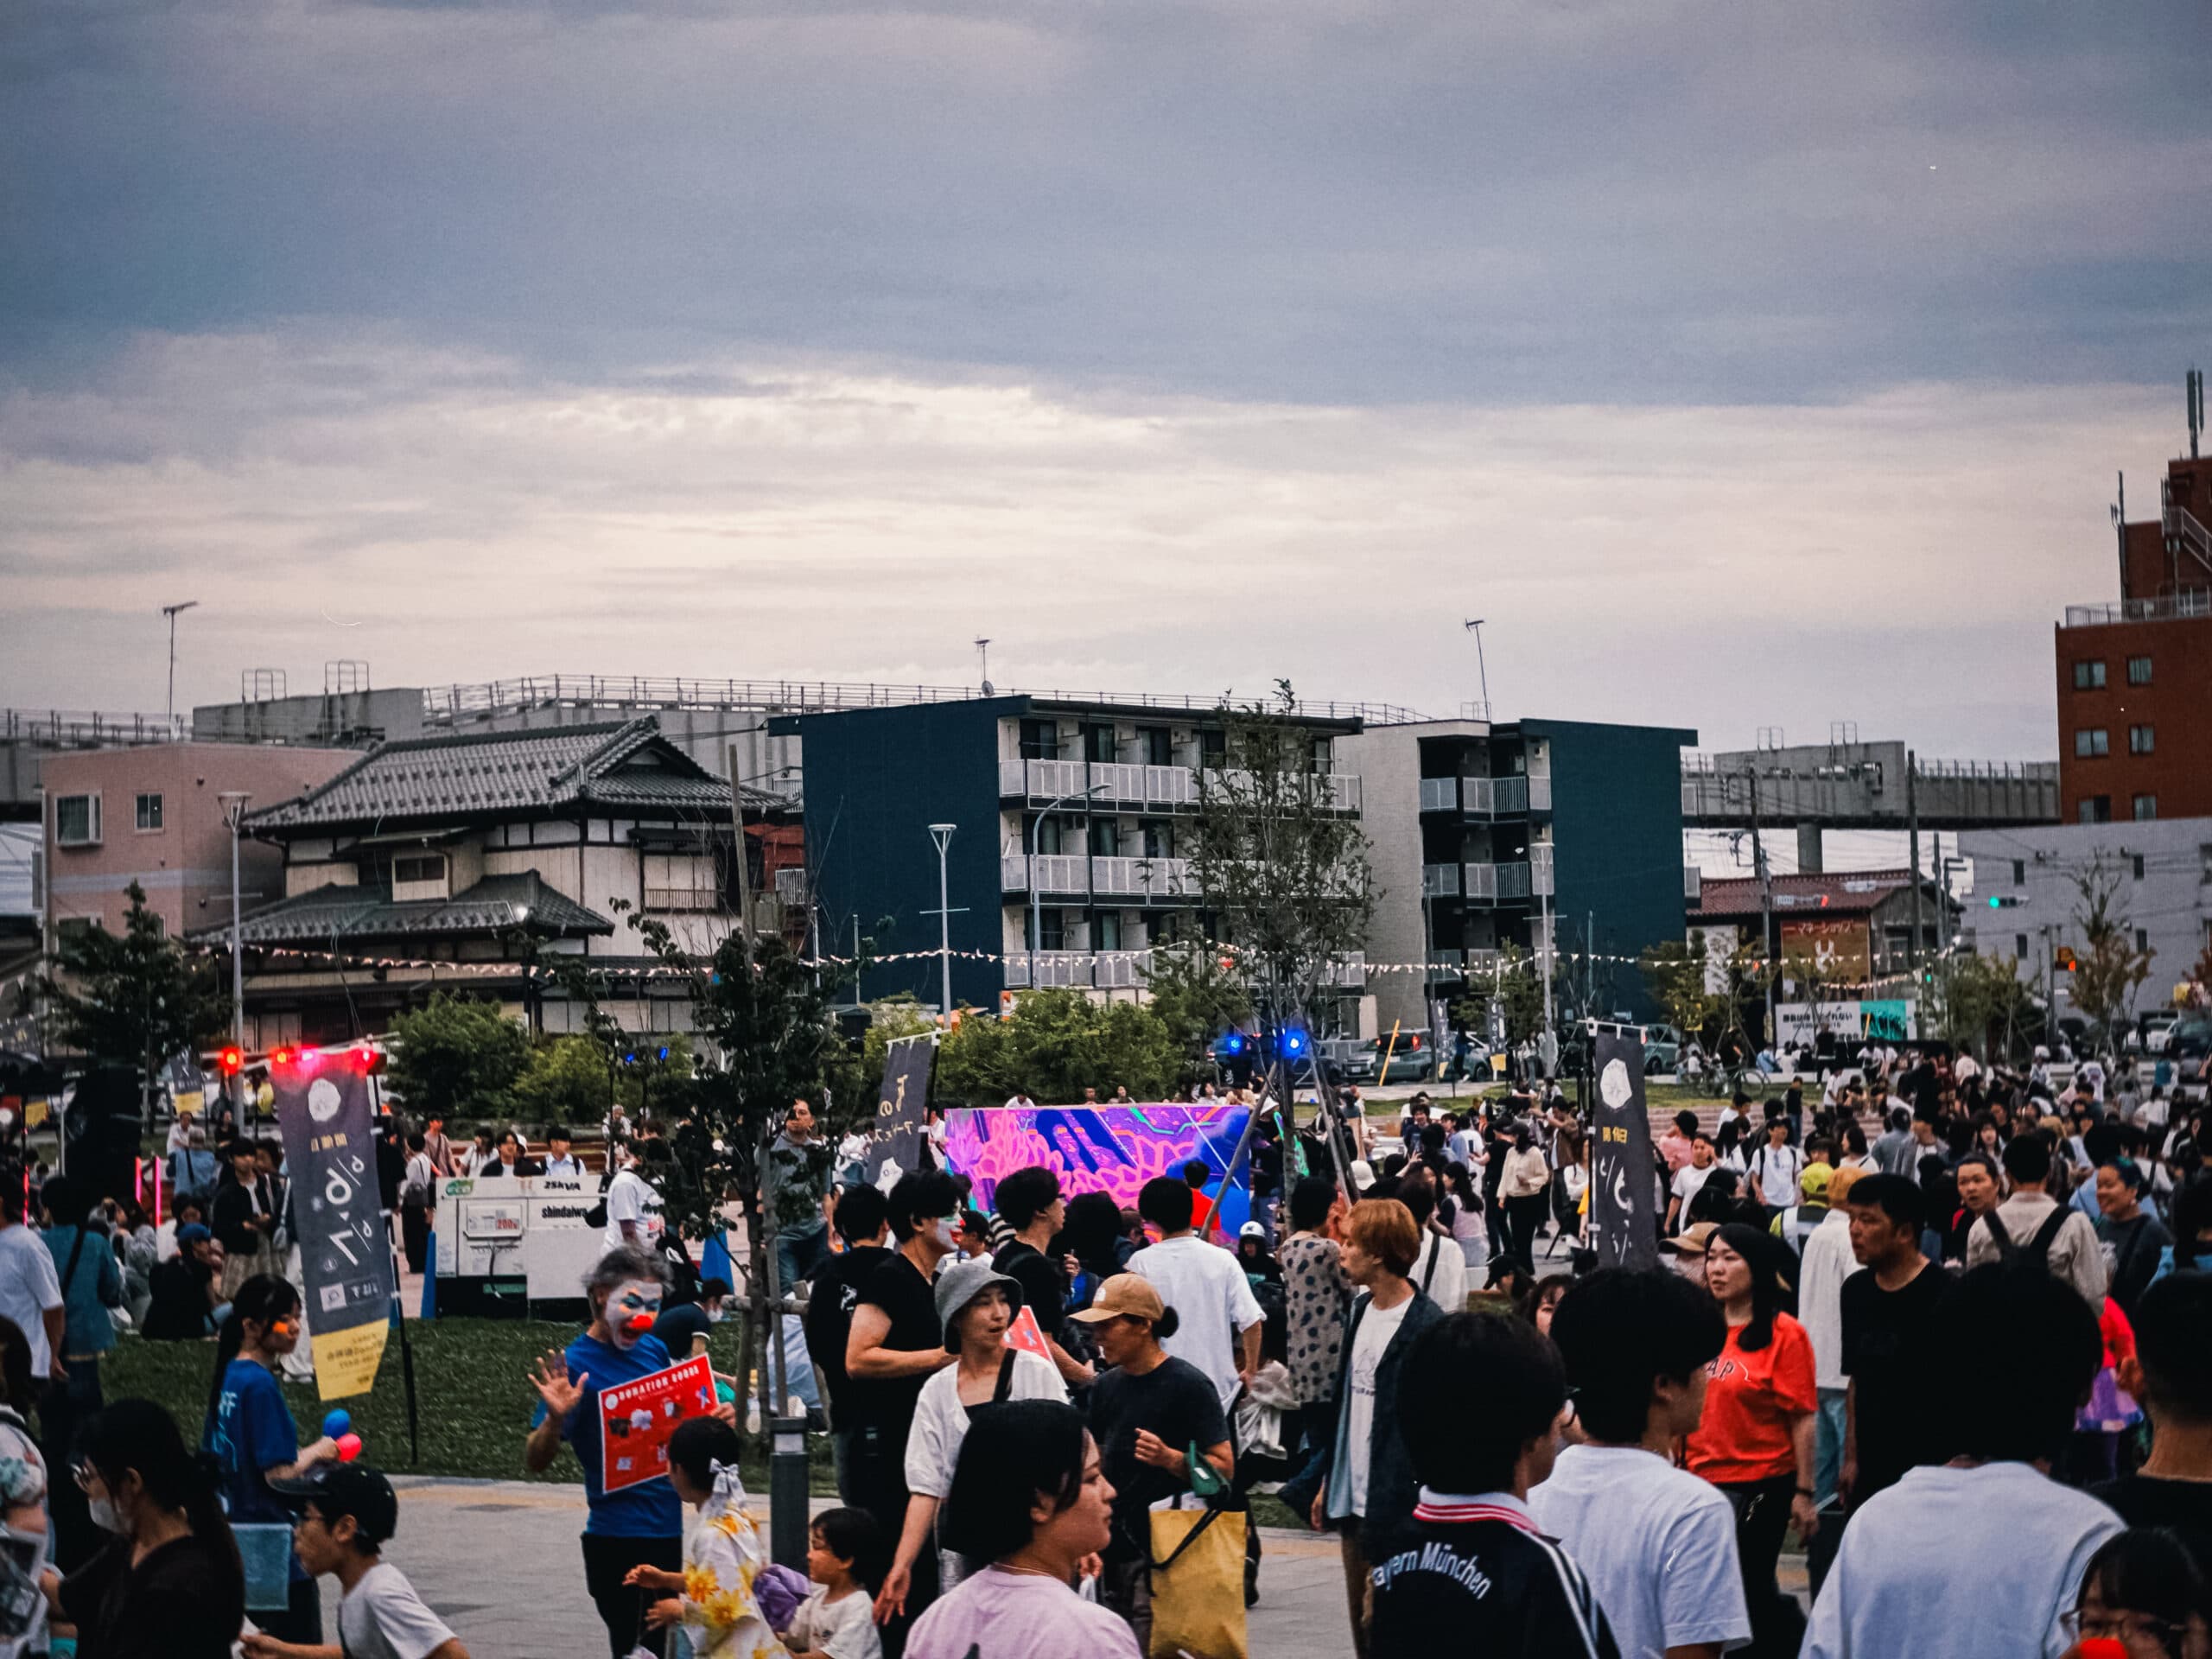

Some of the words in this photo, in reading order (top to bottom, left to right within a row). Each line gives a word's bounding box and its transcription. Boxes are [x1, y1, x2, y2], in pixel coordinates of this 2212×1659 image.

[618, 1376, 669, 1402] DONATION
[1372, 1550, 1419, 1591] ayern
[1418, 1541, 1492, 1600] München
